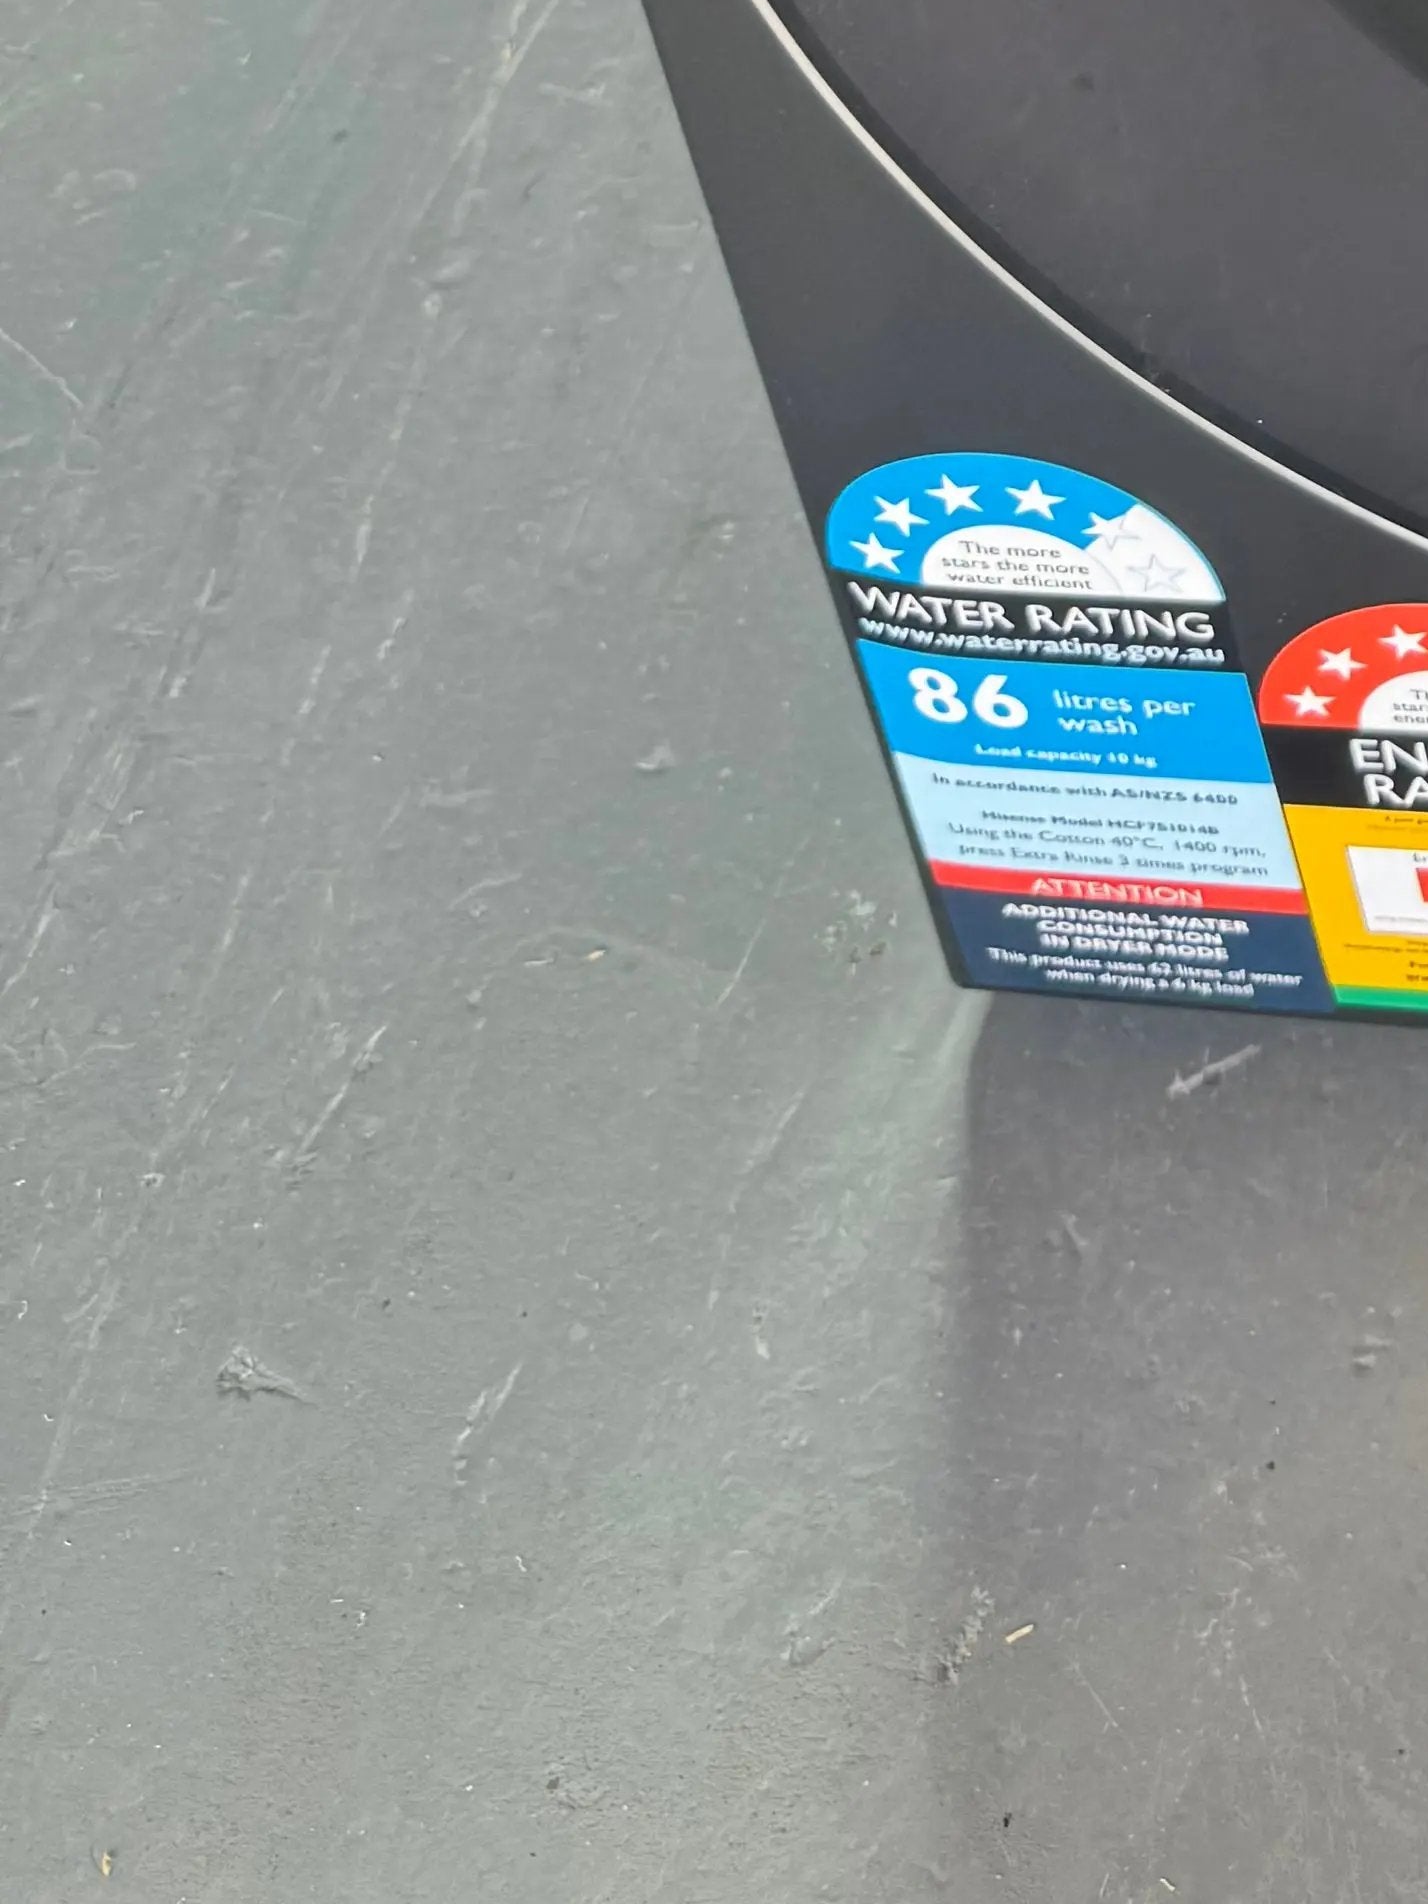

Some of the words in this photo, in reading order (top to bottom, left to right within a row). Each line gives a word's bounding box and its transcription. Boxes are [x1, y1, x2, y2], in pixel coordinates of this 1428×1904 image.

[846, 580, 1015, 634] WATER
[1023, 602, 1215, 644] RATING
[855, 616, 1226, 667] www.waterrating.gov.au
[906, 666, 1030, 730] 86
[1051, 688, 1134, 714] litres
[1142, 697, 1197, 720] per
[1056, 714, 1139, 737] wash
[1030, 876, 1205, 910] ATTENTION
